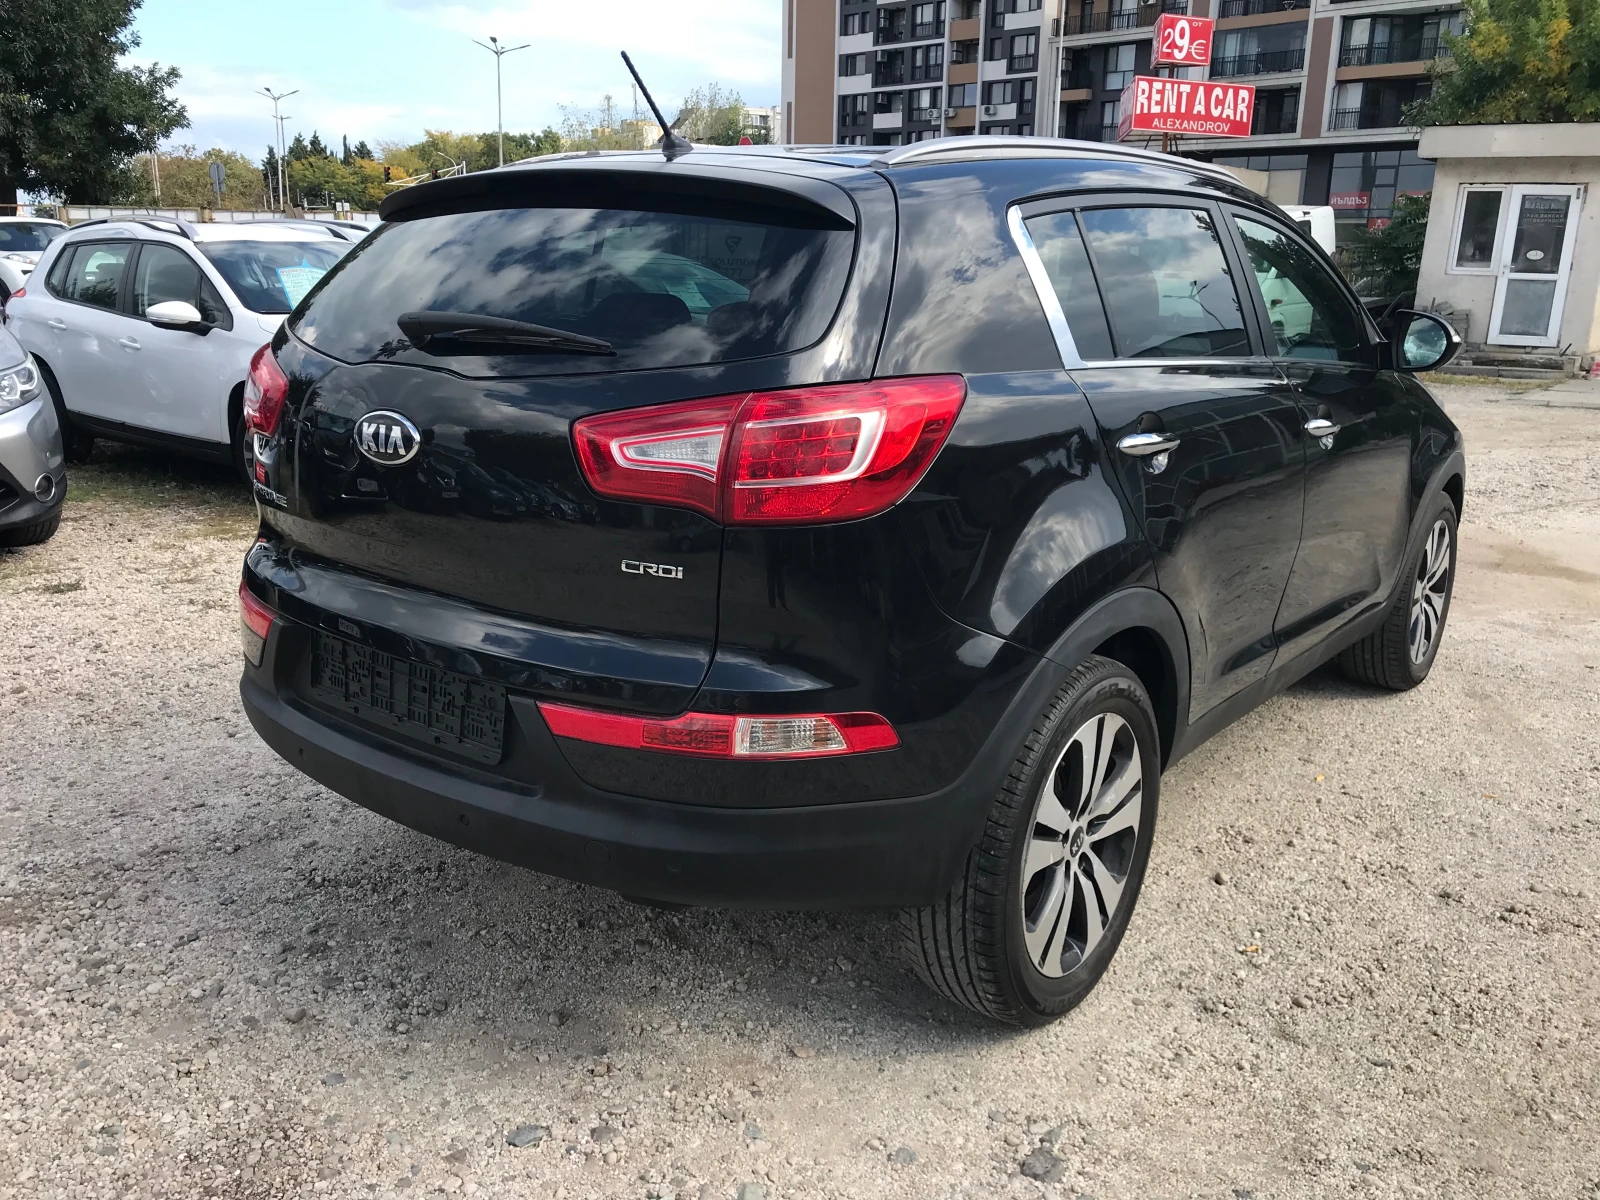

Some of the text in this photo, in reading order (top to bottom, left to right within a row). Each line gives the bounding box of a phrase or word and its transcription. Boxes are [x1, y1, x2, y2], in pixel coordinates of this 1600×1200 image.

[1162, 19, 1207, 60] 29€
[1136, 80, 1191, 115] RENT
[1193, 85, 1206, 115] A
[1210, 87, 1250, 123] CAR
[1152, 117, 1231, 133] ALEXANDROV
[1330, 195, 1367, 206] ЙЪЛДЪЗ
[361, 421, 407, 456] KIA
